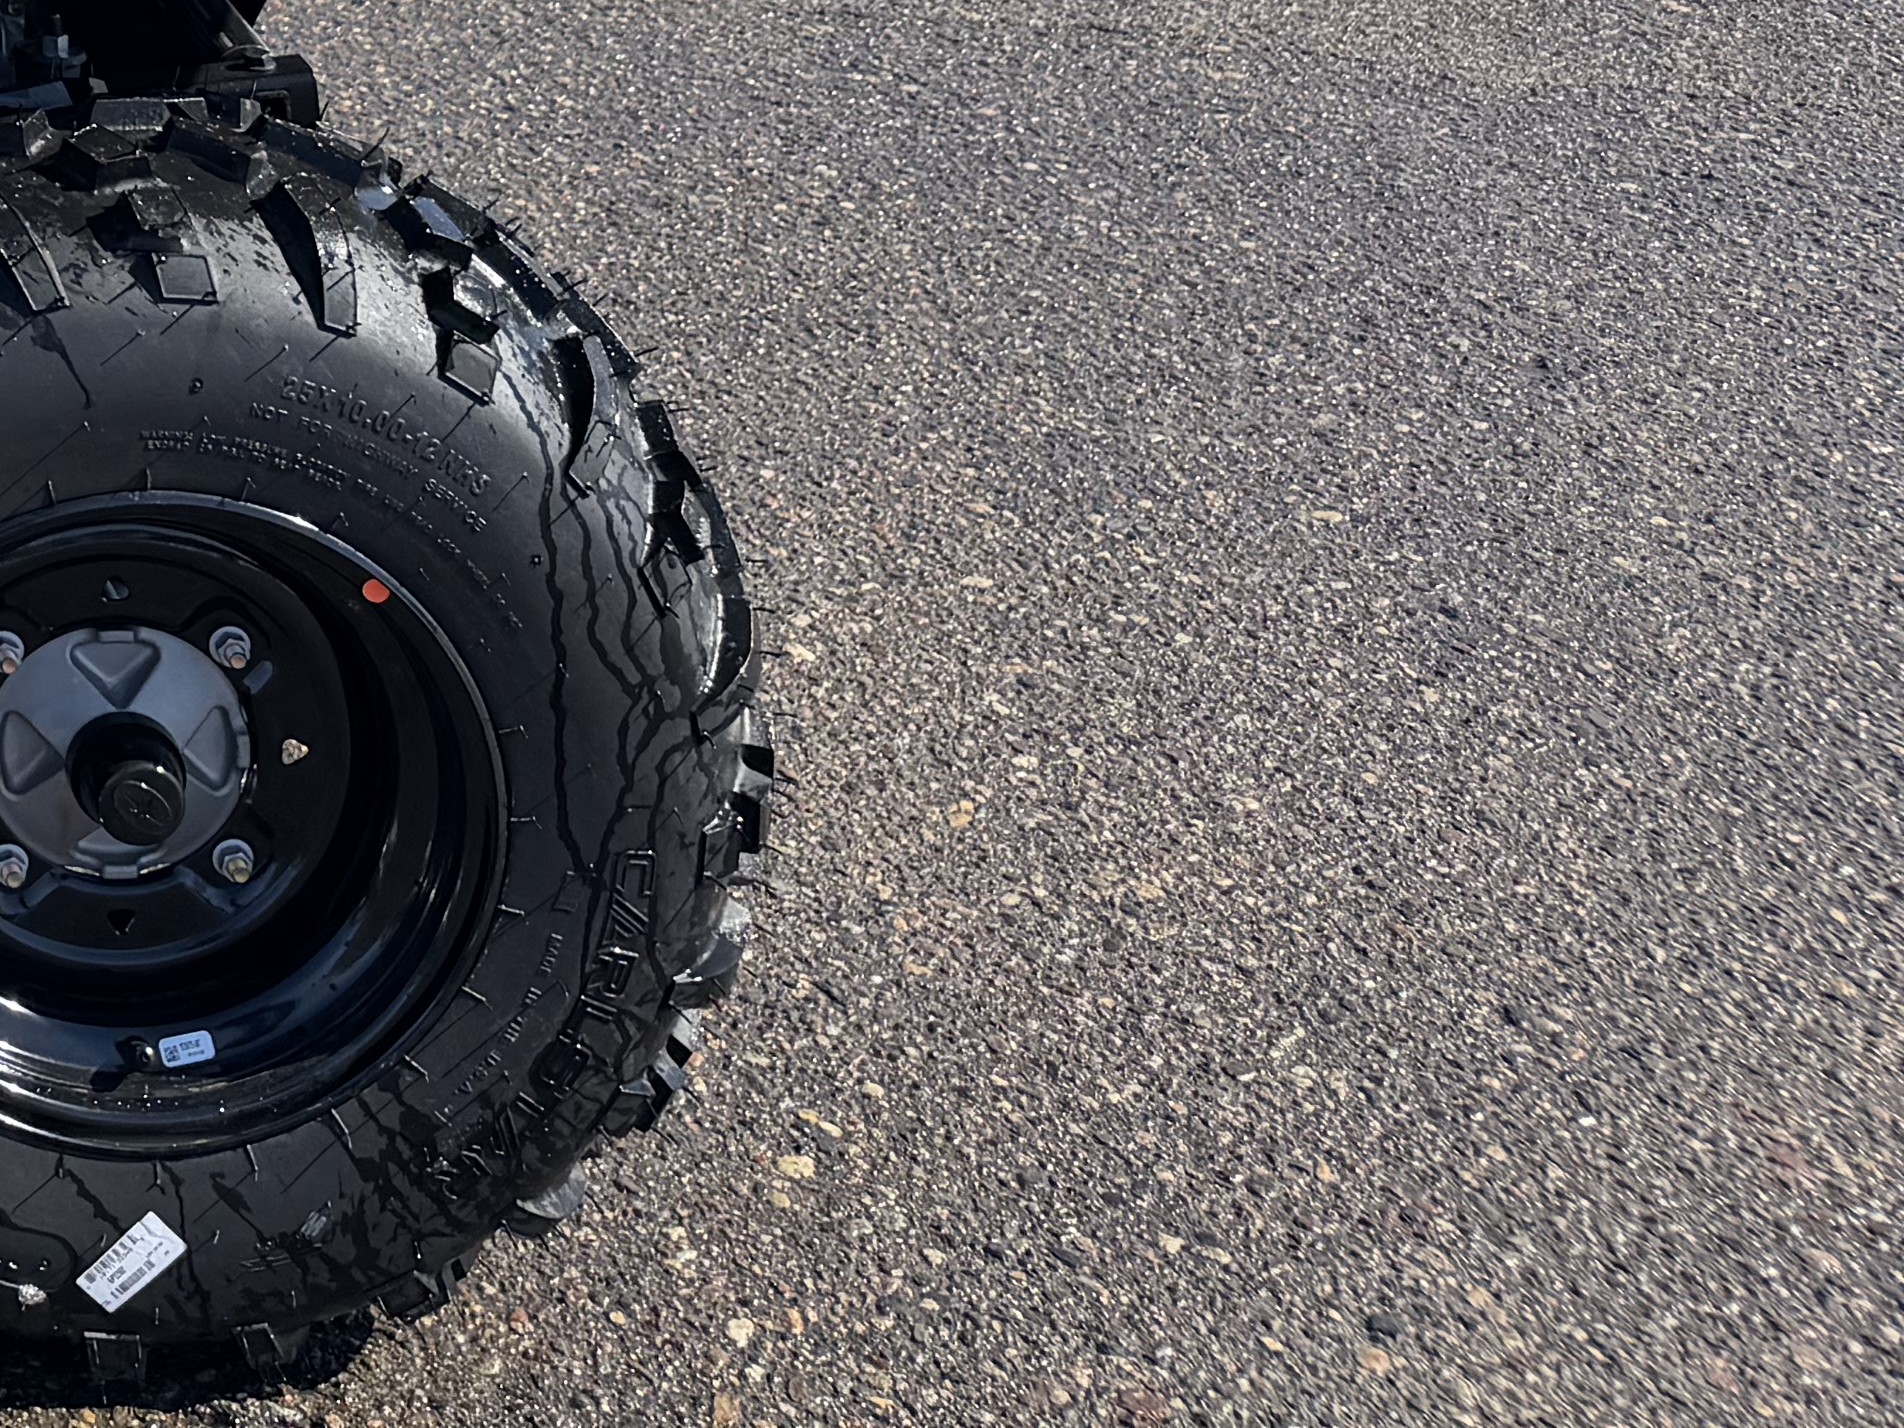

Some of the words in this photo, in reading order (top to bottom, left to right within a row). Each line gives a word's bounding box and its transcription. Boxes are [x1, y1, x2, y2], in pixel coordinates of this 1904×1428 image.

[251, 401, 289, 422] NOT
[298, 415, 334, 439] FOR
[424, 478, 488, 531] SERVICE
